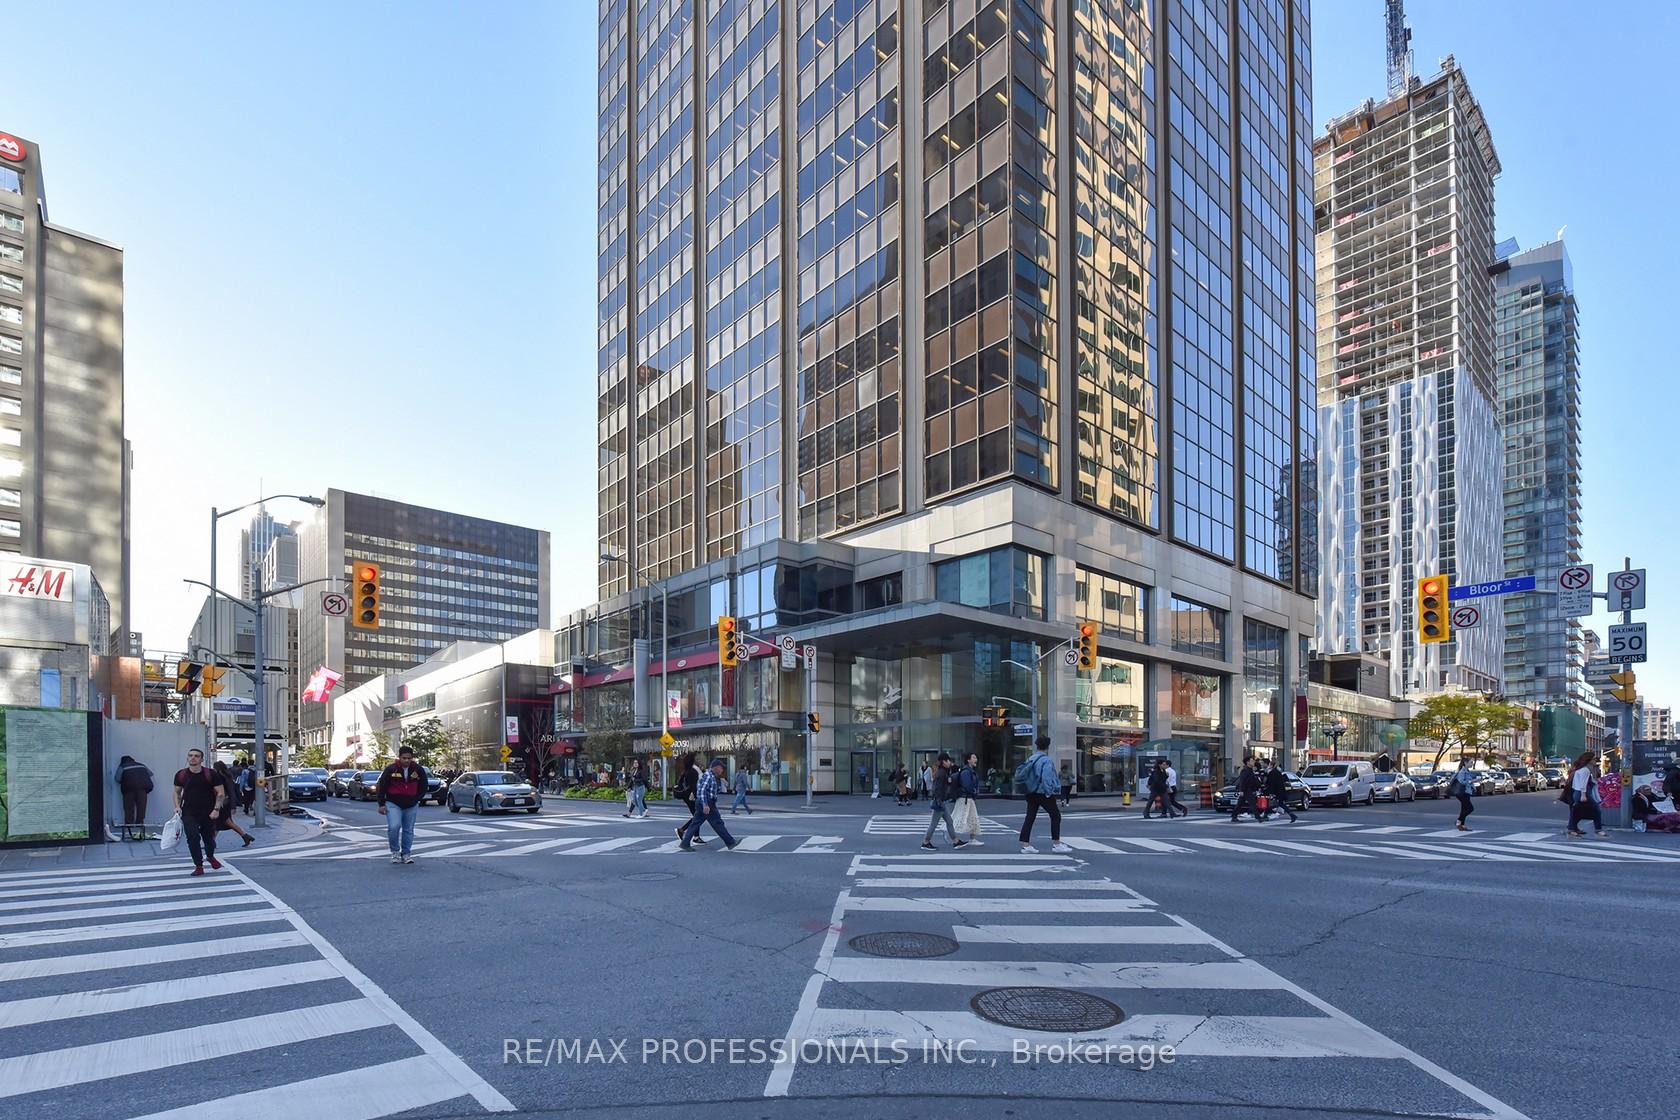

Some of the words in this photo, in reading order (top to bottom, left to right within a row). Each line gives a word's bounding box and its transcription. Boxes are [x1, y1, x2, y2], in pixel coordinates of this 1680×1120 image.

[8, 566, 66, 599] H&M
[1469, 583, 1503, 595] Bloor
[1611, 626, 1644, 634] MAXIMUM
[1612, 635, 1643, 652] 50
[1611, 654, 1644, 664] BEGINS
